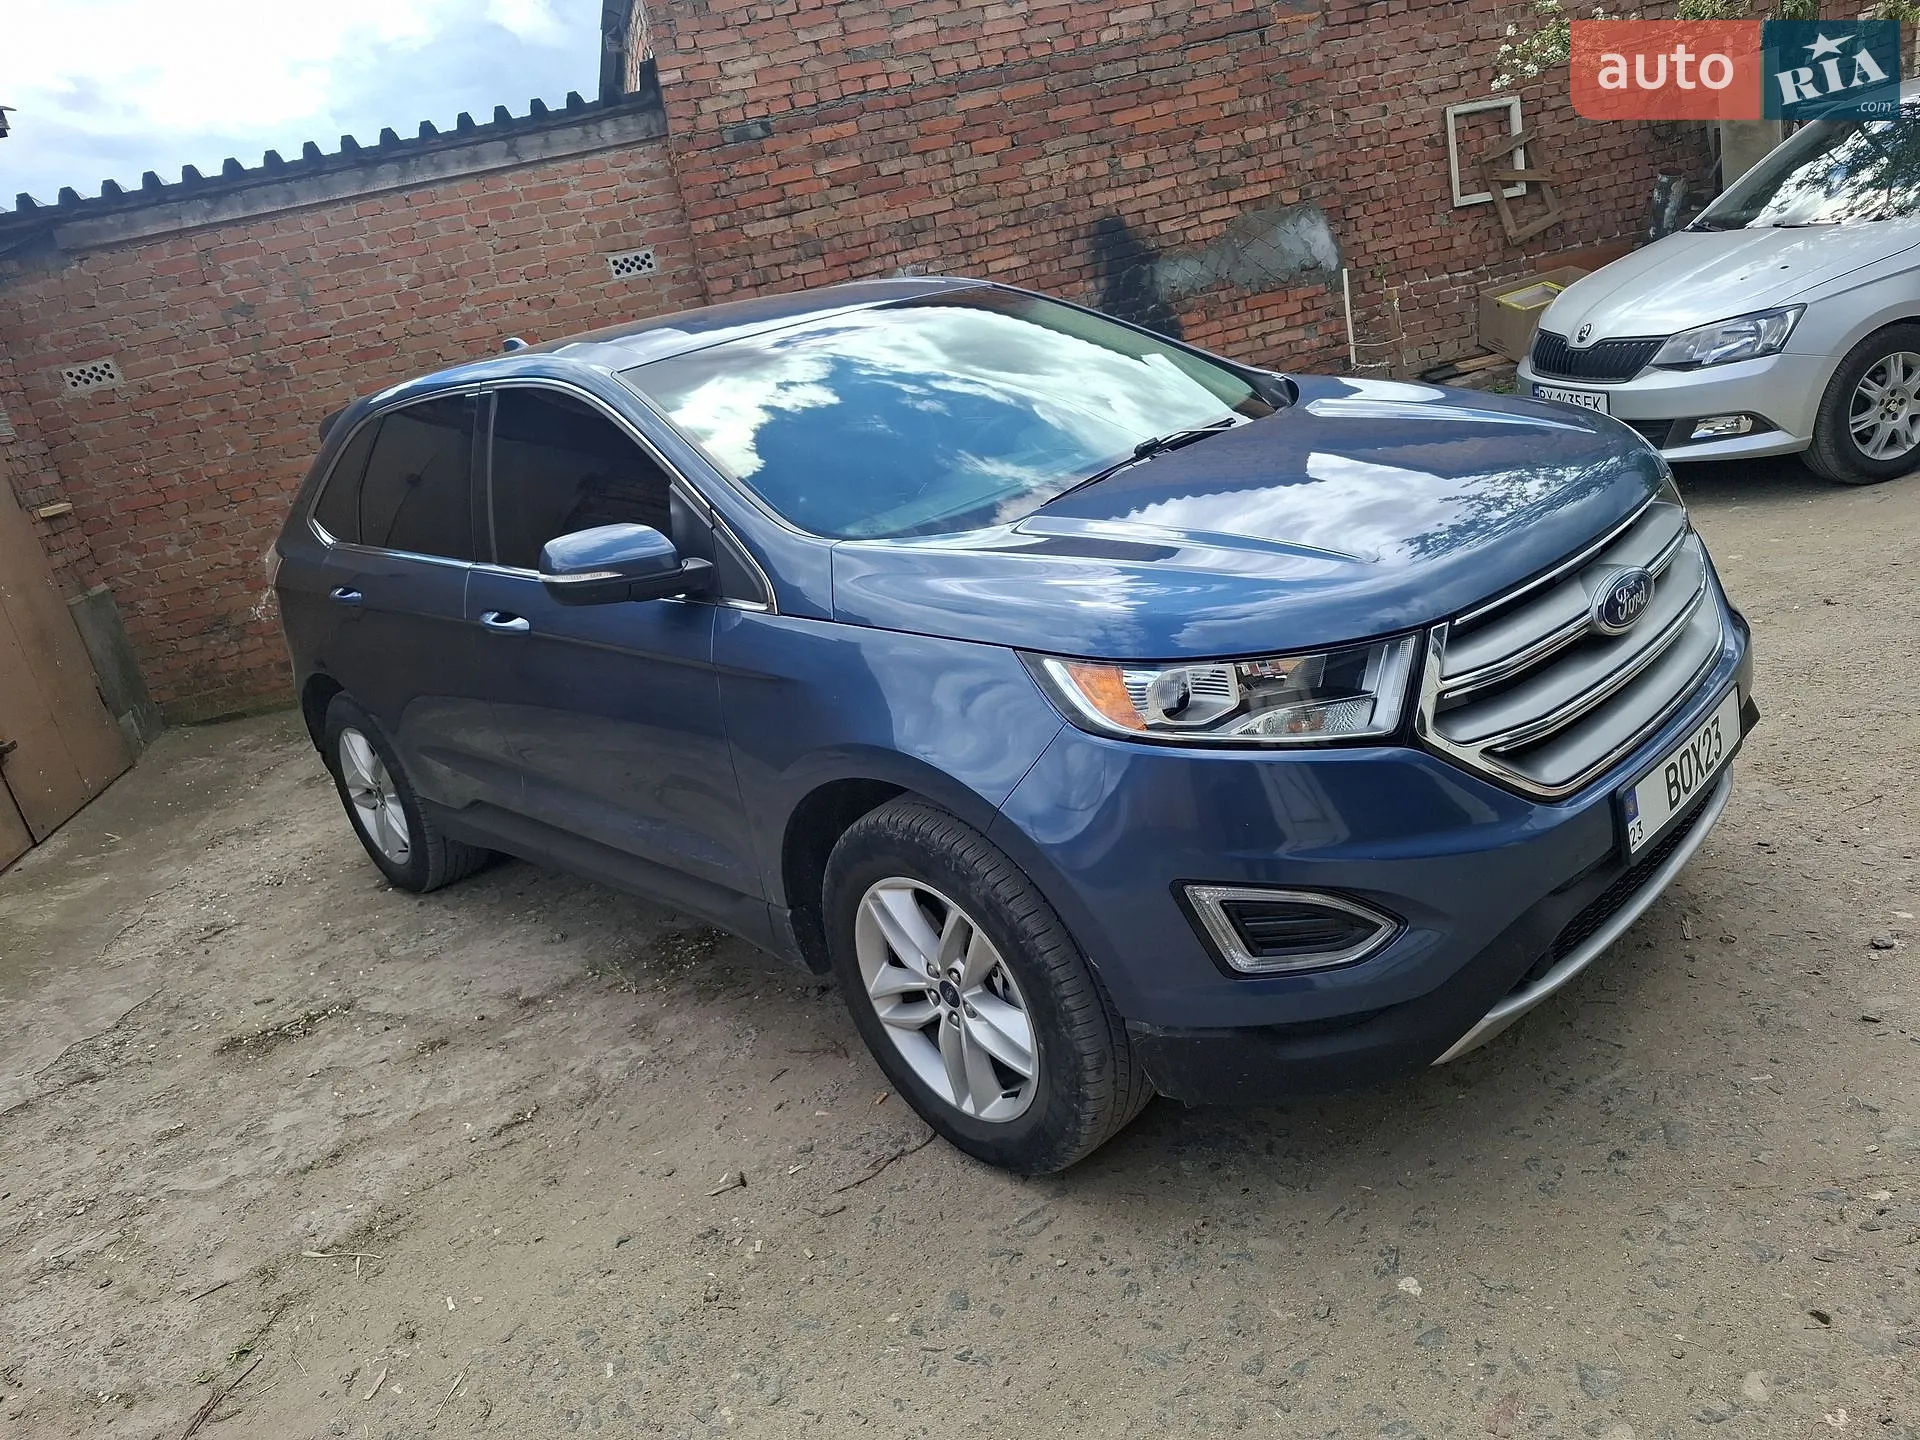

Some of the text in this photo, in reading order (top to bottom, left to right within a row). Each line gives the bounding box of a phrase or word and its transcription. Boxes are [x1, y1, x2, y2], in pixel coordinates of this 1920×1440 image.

[1615, 579, 1648, 621] Ford
[1665, 714, 1722, 812] BOX23
[1629, 821, 1644, 848] 23
